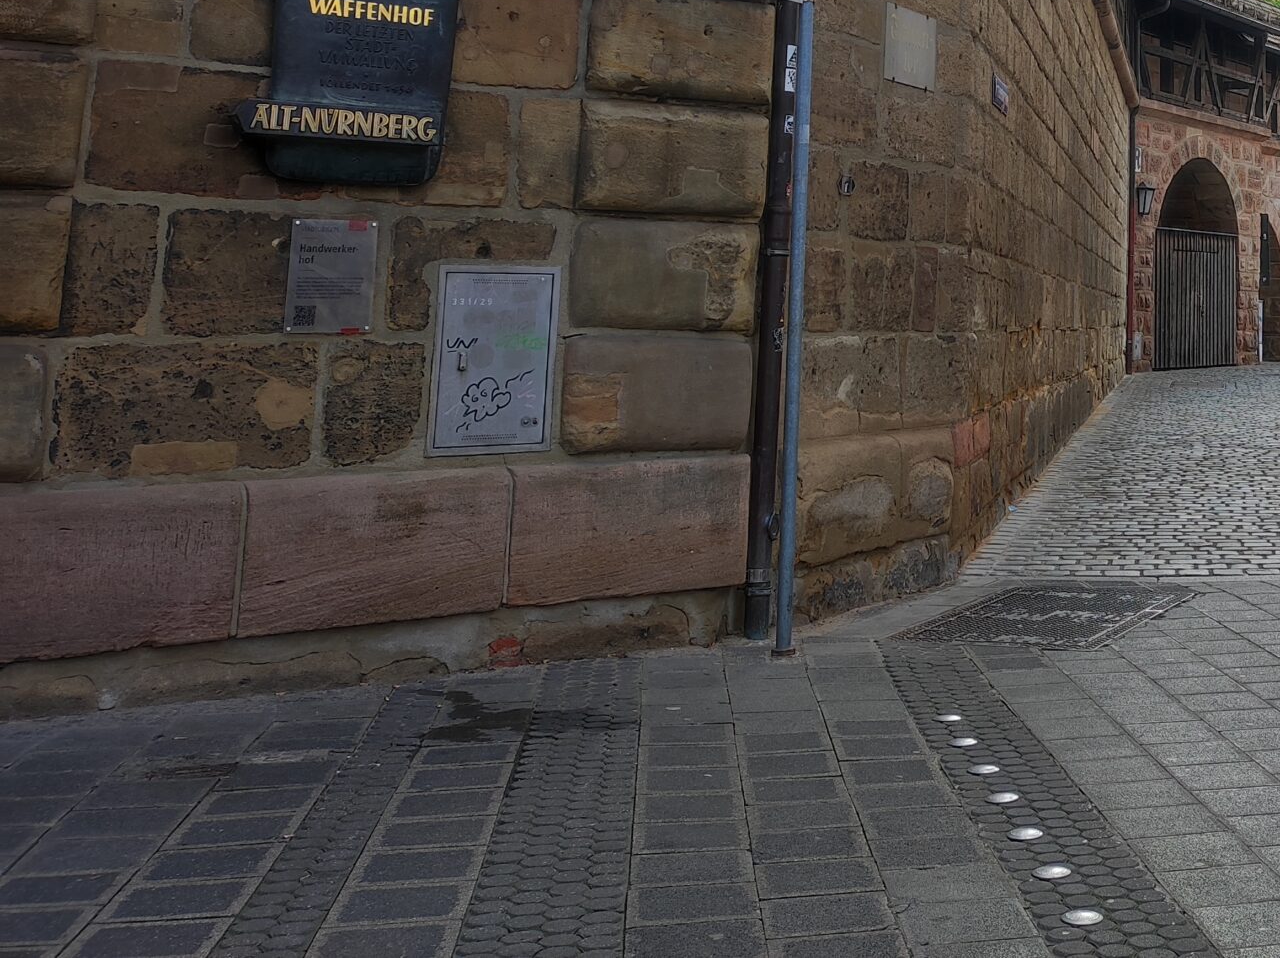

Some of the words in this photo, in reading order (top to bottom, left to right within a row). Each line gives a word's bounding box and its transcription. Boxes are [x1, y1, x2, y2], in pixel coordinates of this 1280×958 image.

[325, 19, 353, 36] DER
[354, 22, 415, 42] LETZTEN
[250, 103, 437, 142] ALT-NÜRNBERG
[299, 243, 359, 254] Handwerker-
[298, 255, 316, 265] hof
